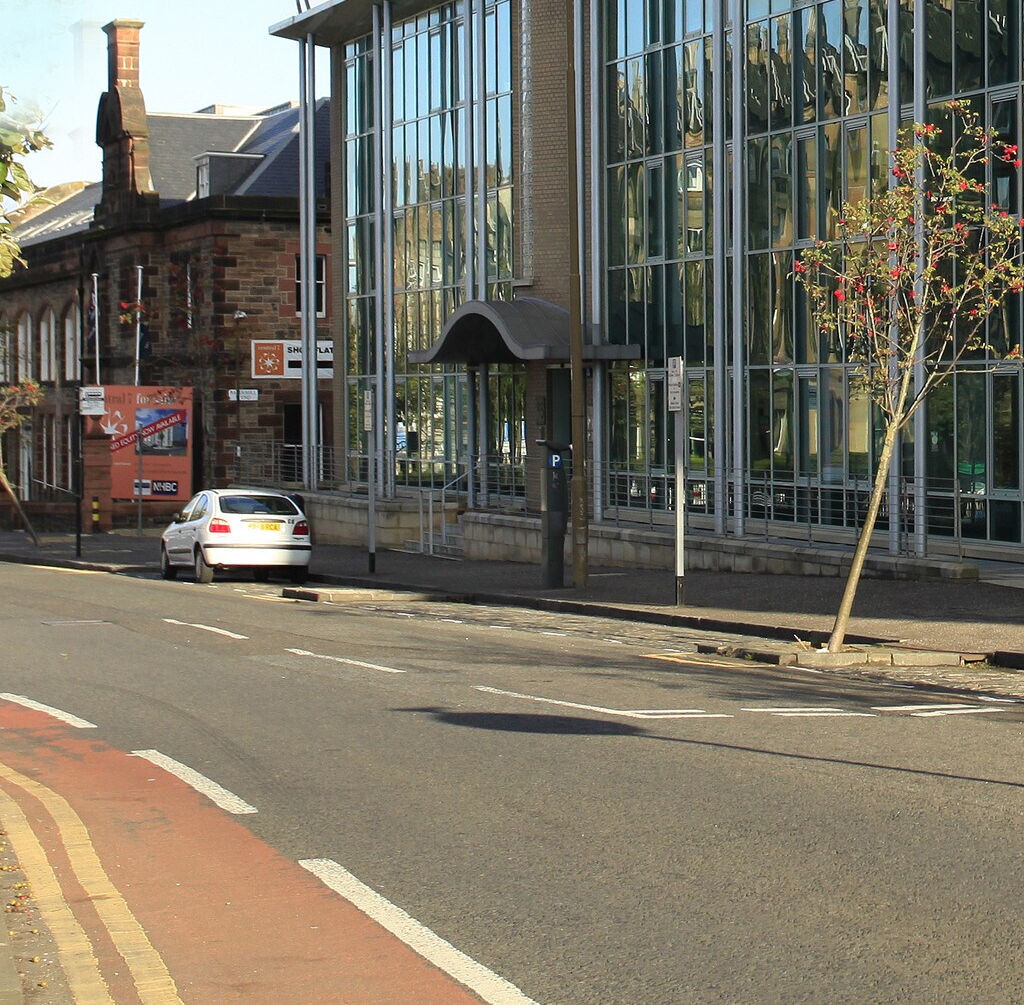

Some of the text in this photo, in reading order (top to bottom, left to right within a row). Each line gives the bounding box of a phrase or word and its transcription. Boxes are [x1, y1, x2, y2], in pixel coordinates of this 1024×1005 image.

[156, 414, 181, 430] AVAILABLE
[551, 454, 561, 467] P
[153, 482, 177, 492] NHBC
